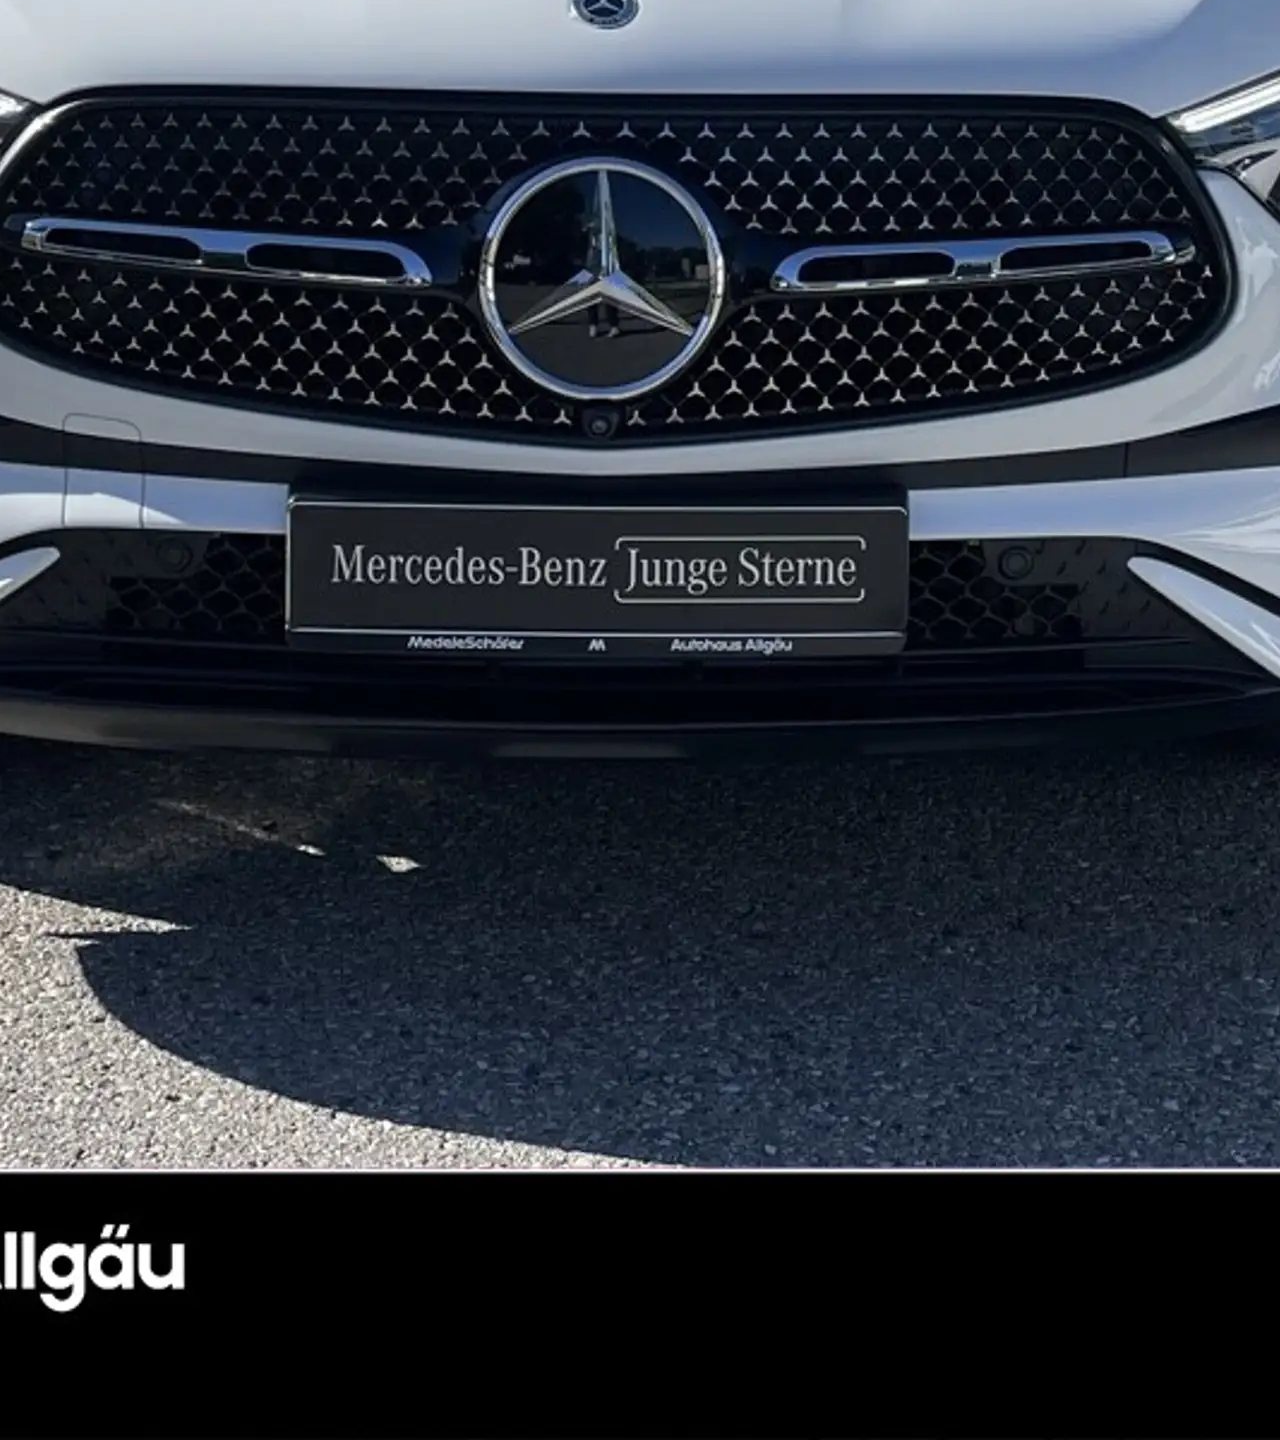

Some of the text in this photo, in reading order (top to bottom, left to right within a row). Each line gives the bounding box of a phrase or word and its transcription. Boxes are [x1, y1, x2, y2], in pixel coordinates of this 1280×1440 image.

[331, 544, 857, 595] Mercedes-Benz Junge Sterne
[670, 637, 742, 652] Autohaus
